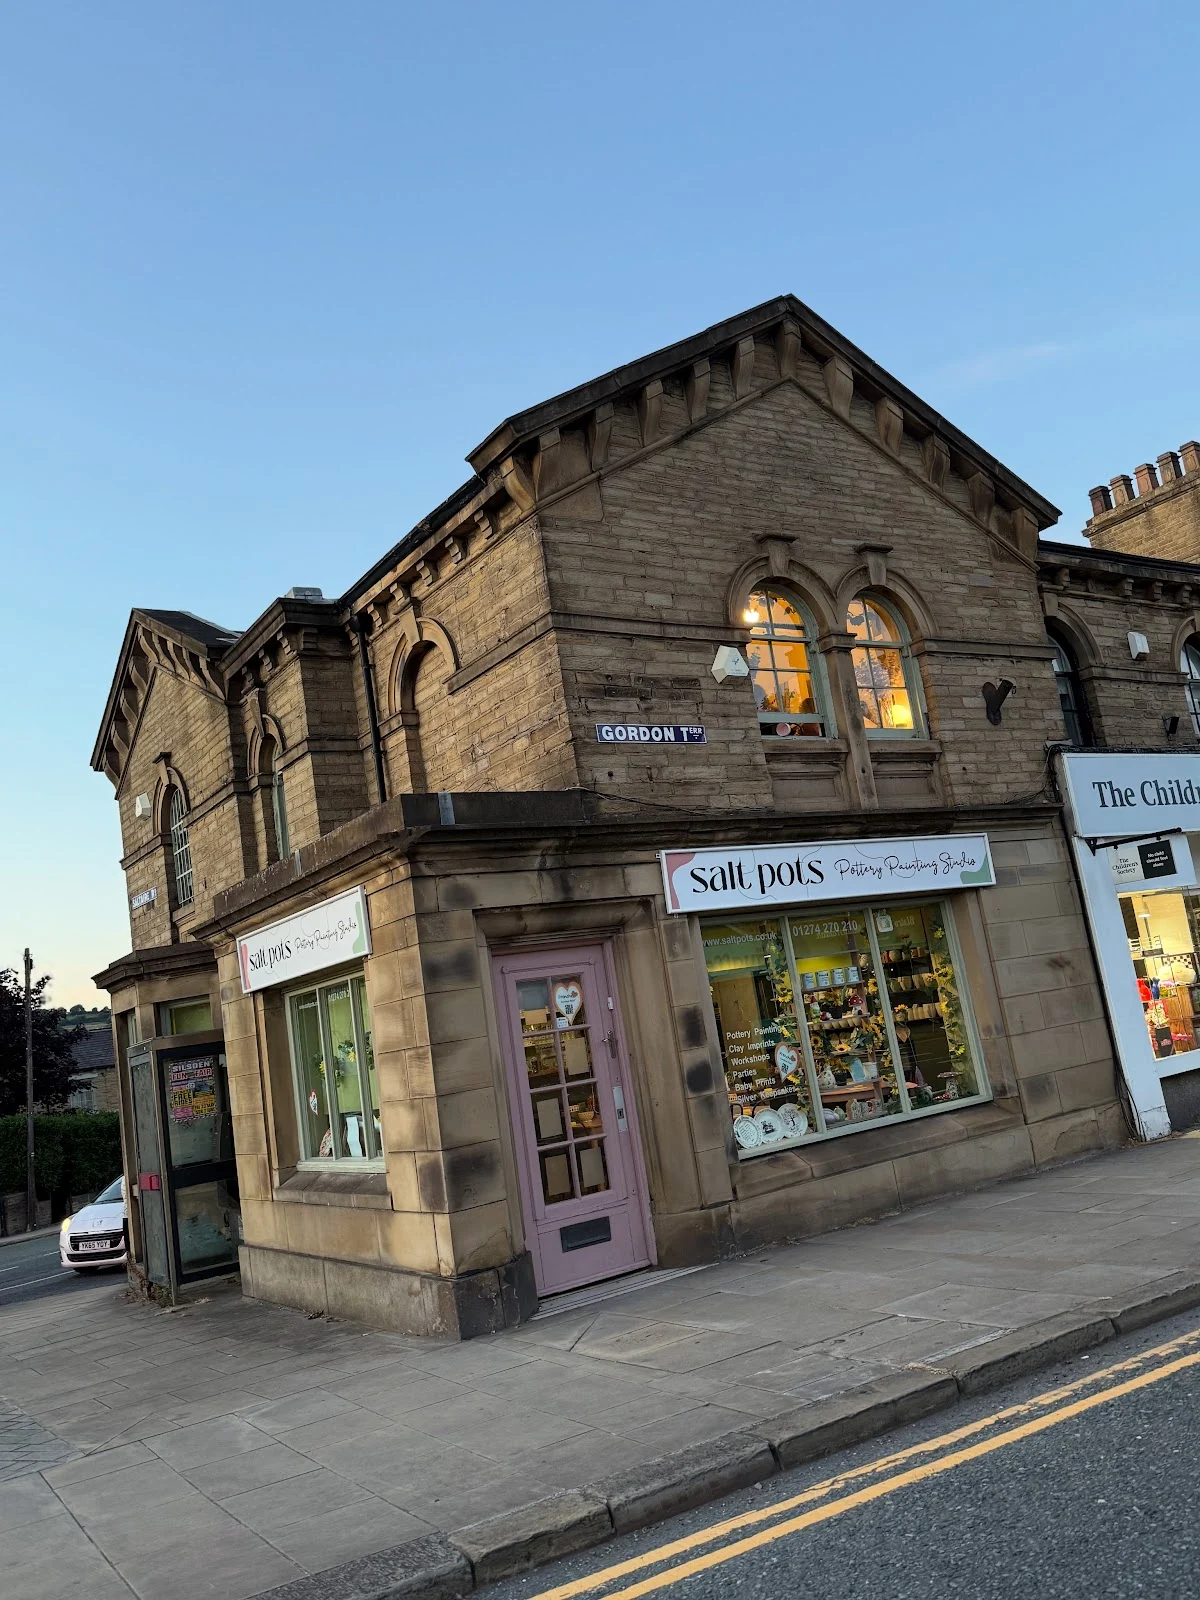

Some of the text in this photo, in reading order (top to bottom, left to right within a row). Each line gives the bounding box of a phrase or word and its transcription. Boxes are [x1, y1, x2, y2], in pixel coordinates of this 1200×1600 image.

[601, 725, 676, 741] GORDON
[1092, 780, 1137, 808] The
[690, 851, 976, 895] salt pots Pottery Painting Studio
[1112, 861, 1139, 871] Children's
[792, 924, 821, 937] 01274
[823, 921, 840, 933] 270
[842, 920, 858, 932] 210
[249, 946, 269, 971] salt
[269, 939, 292, 969] pots
[726, 1025, 782, 1040] Pottery Painting
[728, 1039, 776, 1053] Clay Imprints
[172, 1060, 211, 1072] SILSDEN
[730, 1053, 771, 1066] Workshops
[733, 1068, 757, 1079] Parties
[735, 1077, 776, 1091] Baby Prints
[173, 1092, 193, 1101] FREE
[737, 1085, 796, 1103] Silver Keepsakes
